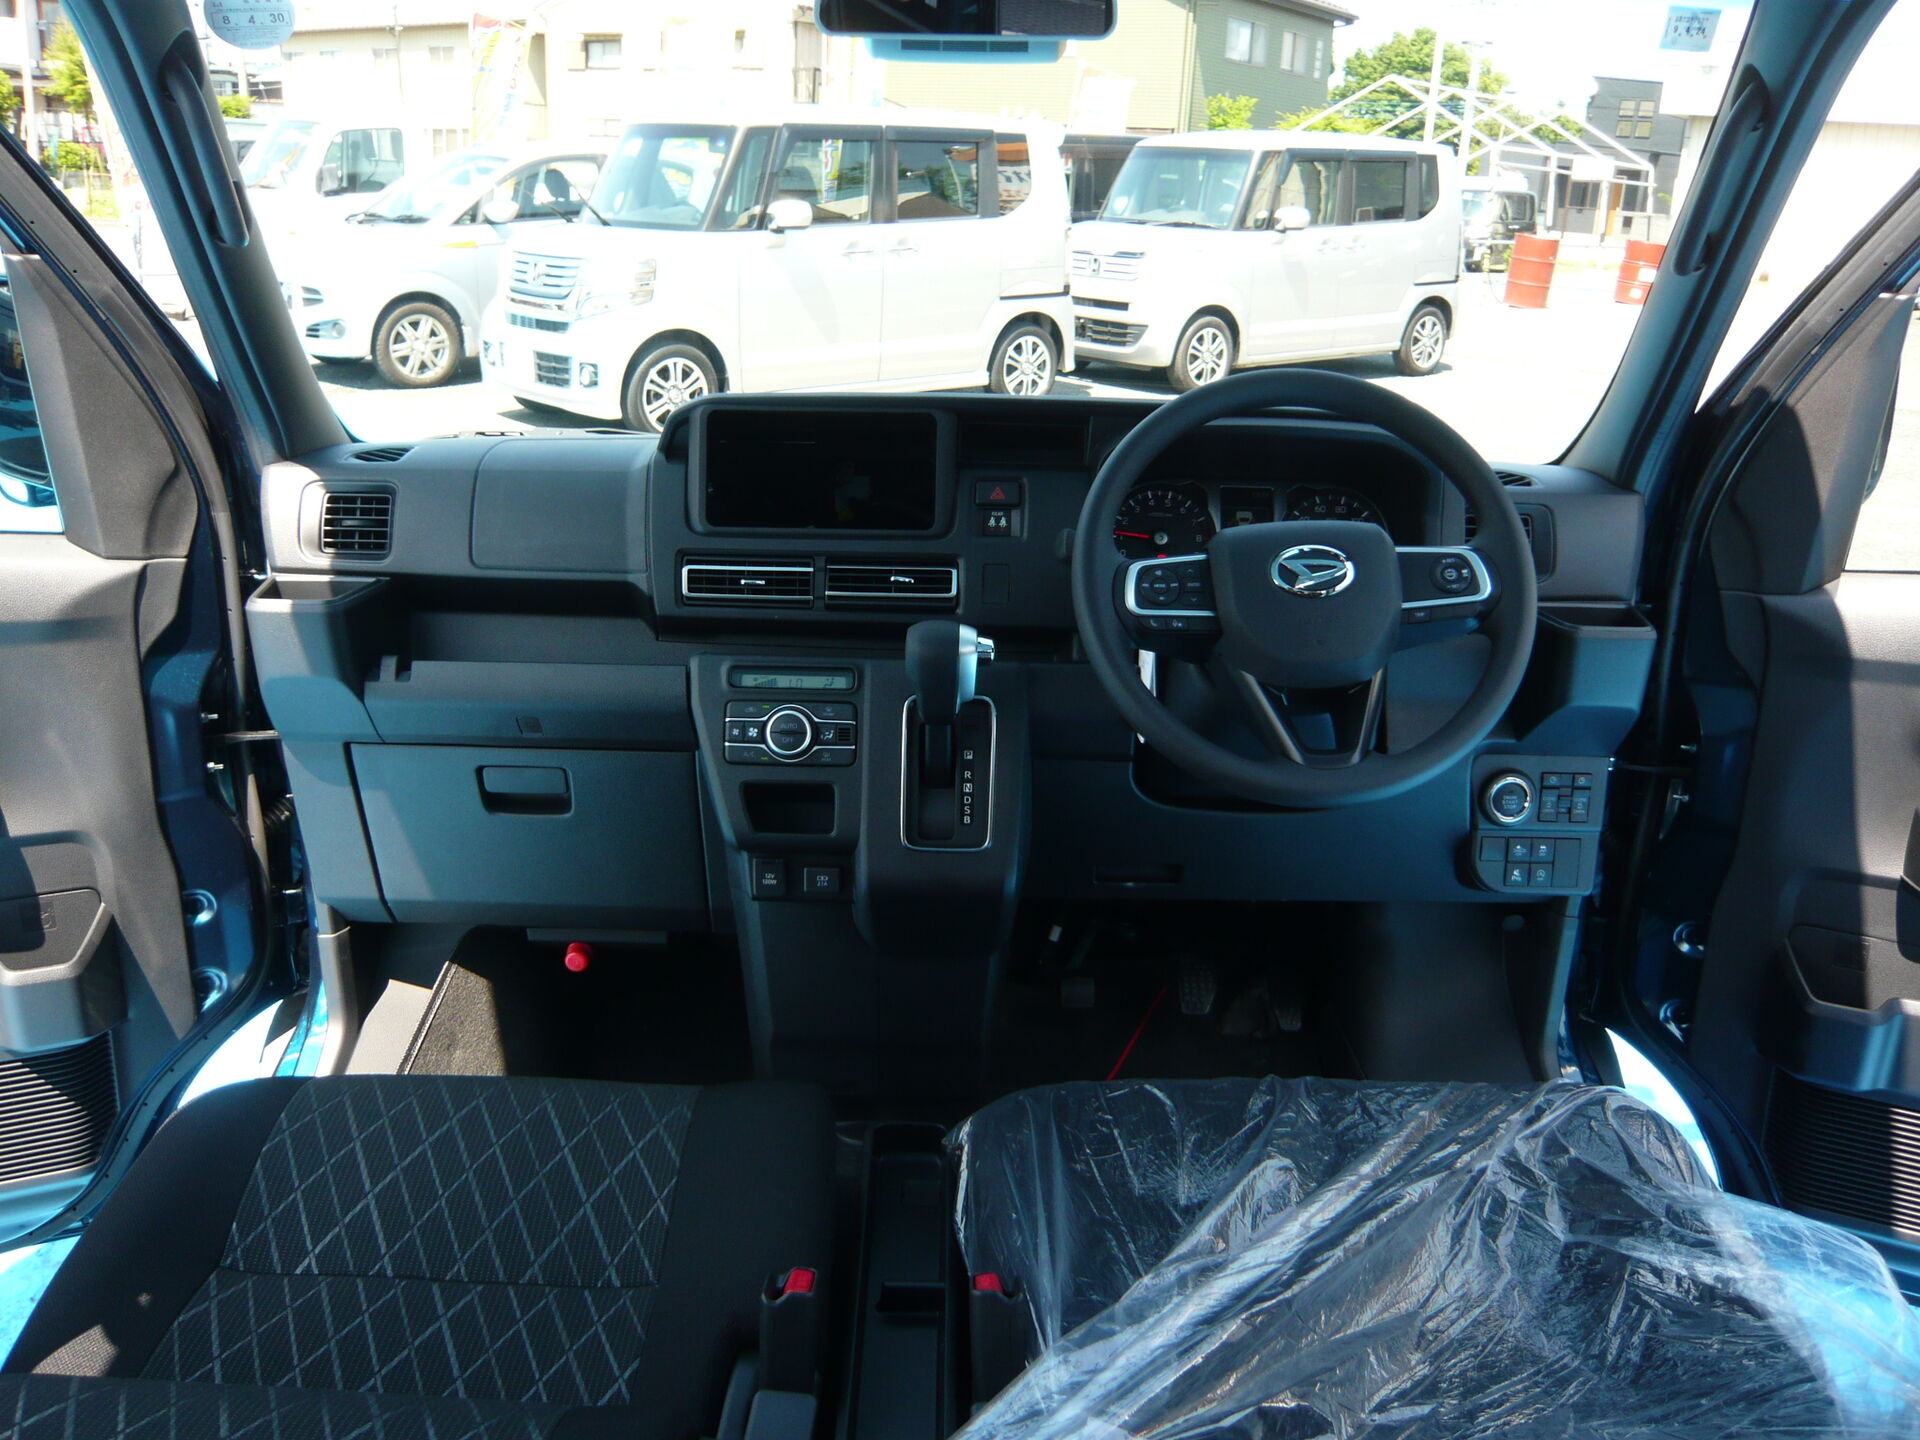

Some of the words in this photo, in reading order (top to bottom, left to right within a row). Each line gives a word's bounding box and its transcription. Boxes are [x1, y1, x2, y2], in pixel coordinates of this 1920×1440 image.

[964, 751, 973, 759] P
[964, 770, 972, 779] R
[964, 784, 972, 792] N
[963, 795, 971, 804] D
[964, 806, 970, 814] S
[964, 816, 970, 824] B
